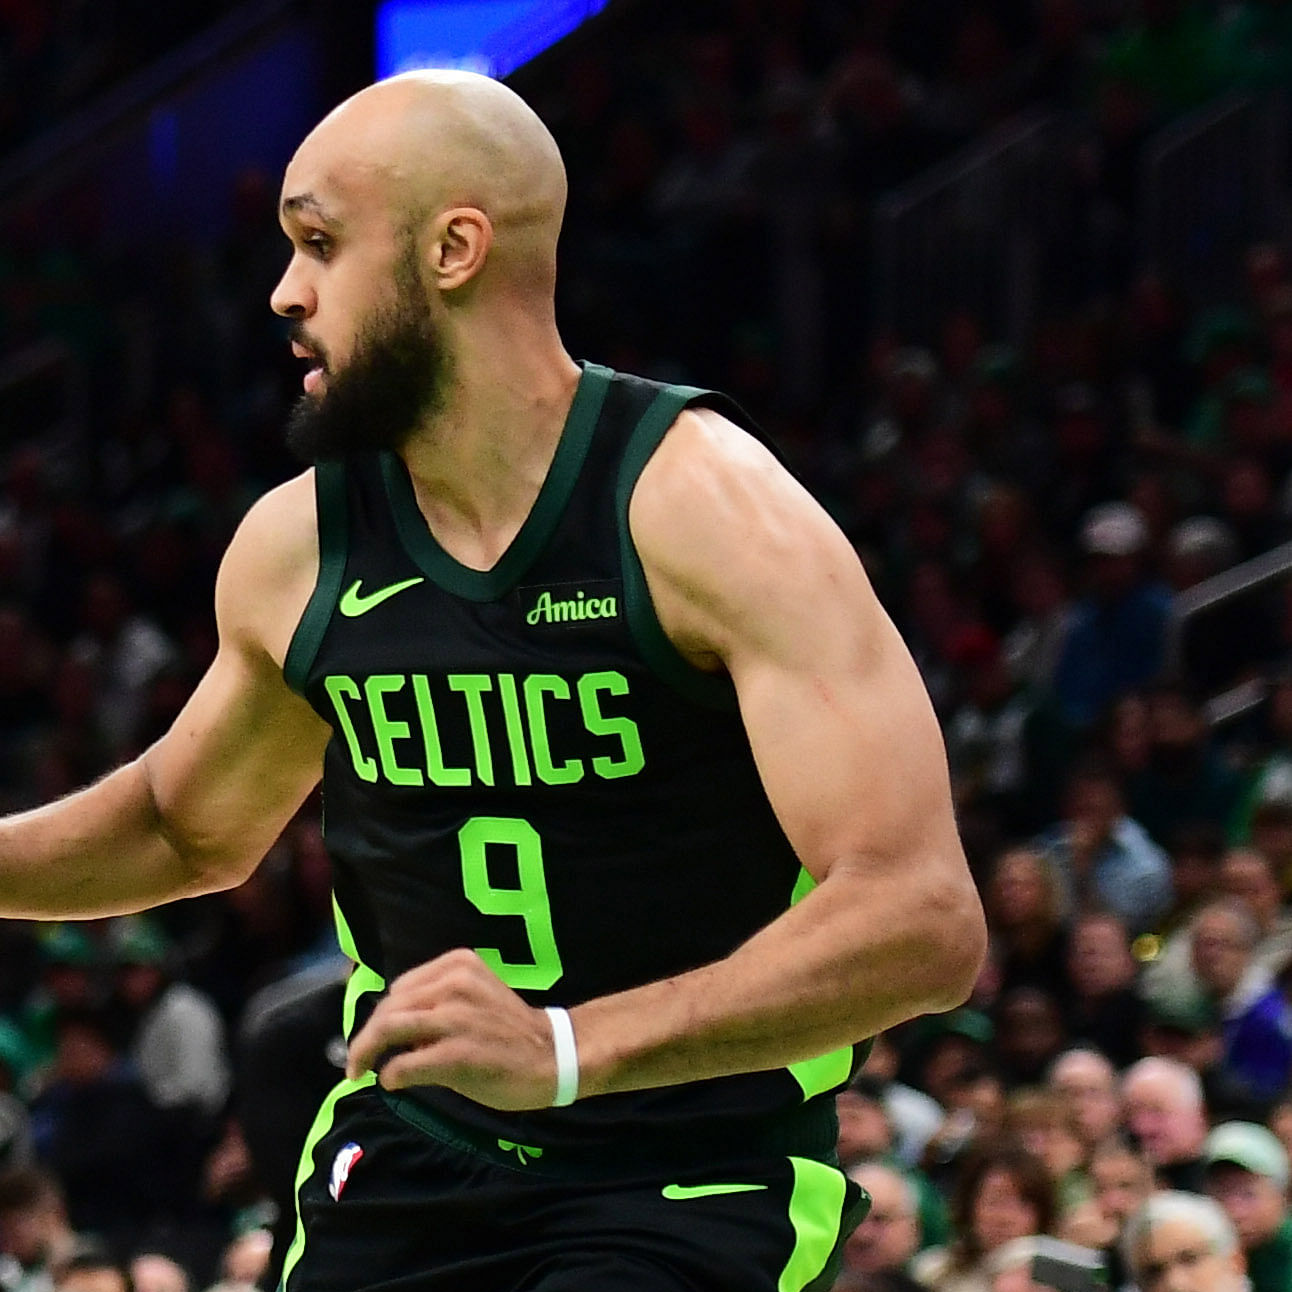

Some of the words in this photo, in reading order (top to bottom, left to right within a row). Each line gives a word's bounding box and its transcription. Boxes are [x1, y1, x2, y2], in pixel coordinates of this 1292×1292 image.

[527, 591, 617, 625] Amica
[324, 671, 645, 786] CELTICS
[458, 816, 563, 991] 9
